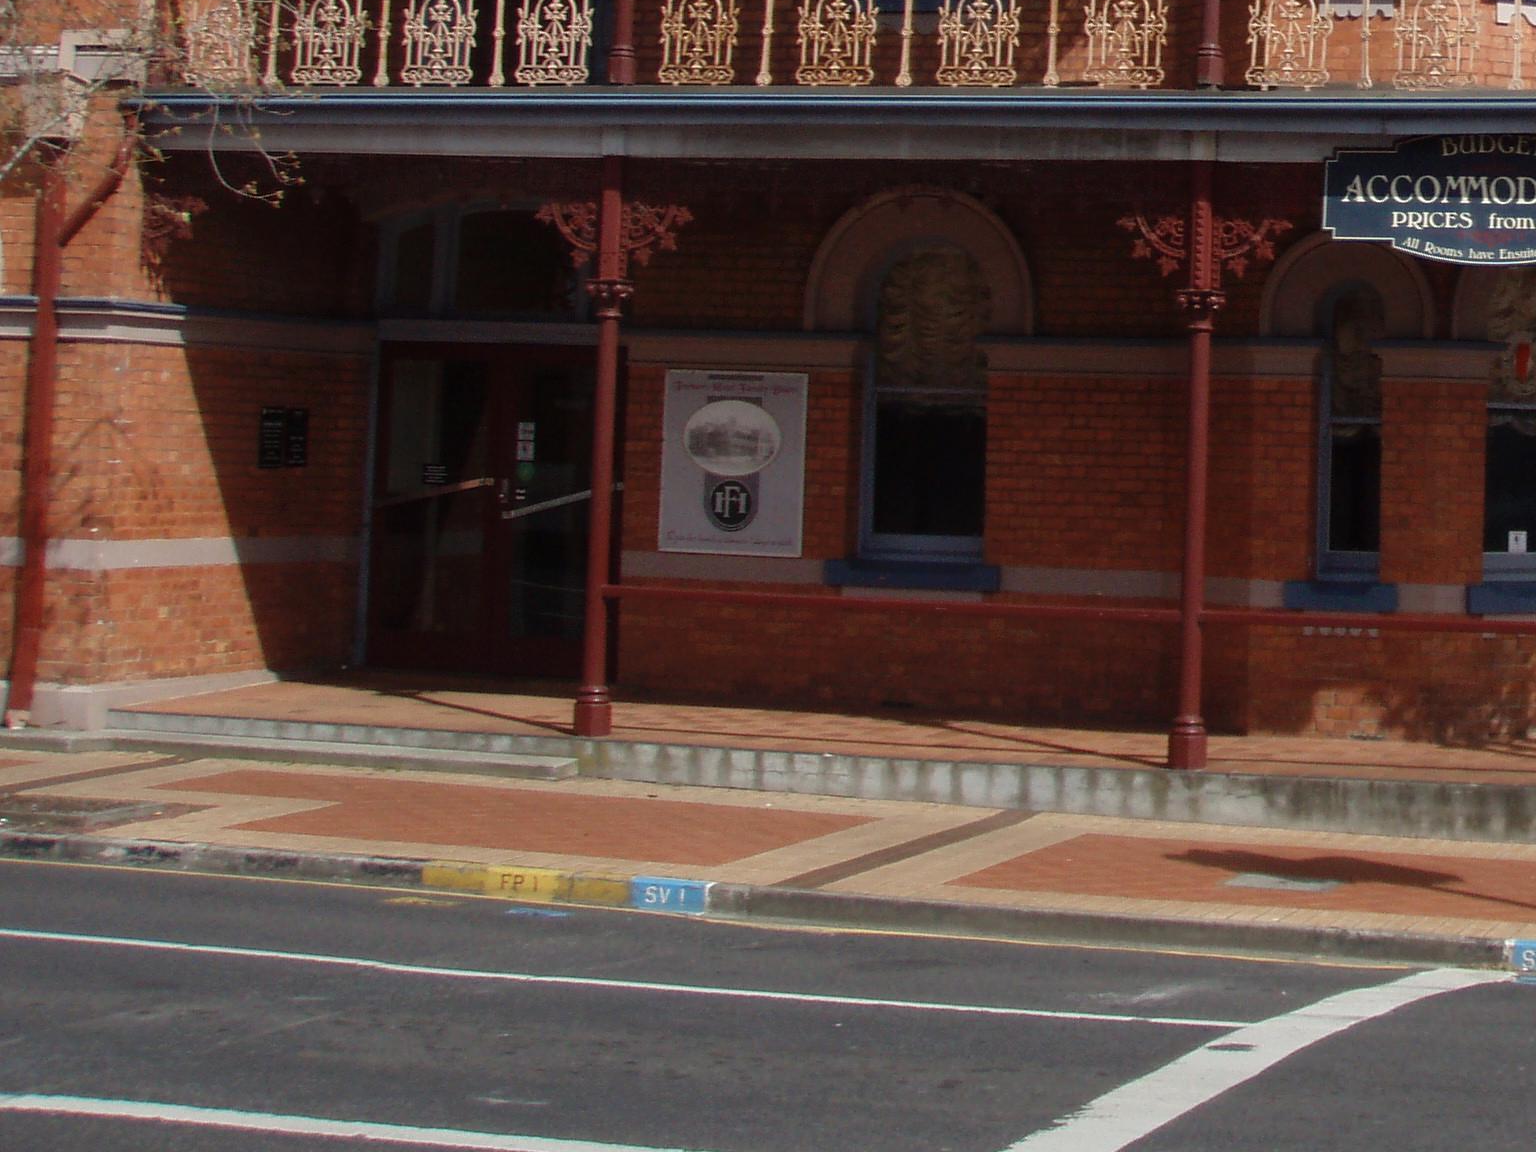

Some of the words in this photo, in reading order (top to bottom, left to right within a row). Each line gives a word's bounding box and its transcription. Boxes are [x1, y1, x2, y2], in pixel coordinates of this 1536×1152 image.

[1391, 211, 1474, 230] PRICES
[1487, 212, 1536, 230] from
[1402, 236, 1421, 249] All
[1424, 241, 1464, 258] Rooms
[1468, 248, 1495, 260] have
[644, 885, 671, 904] SV
